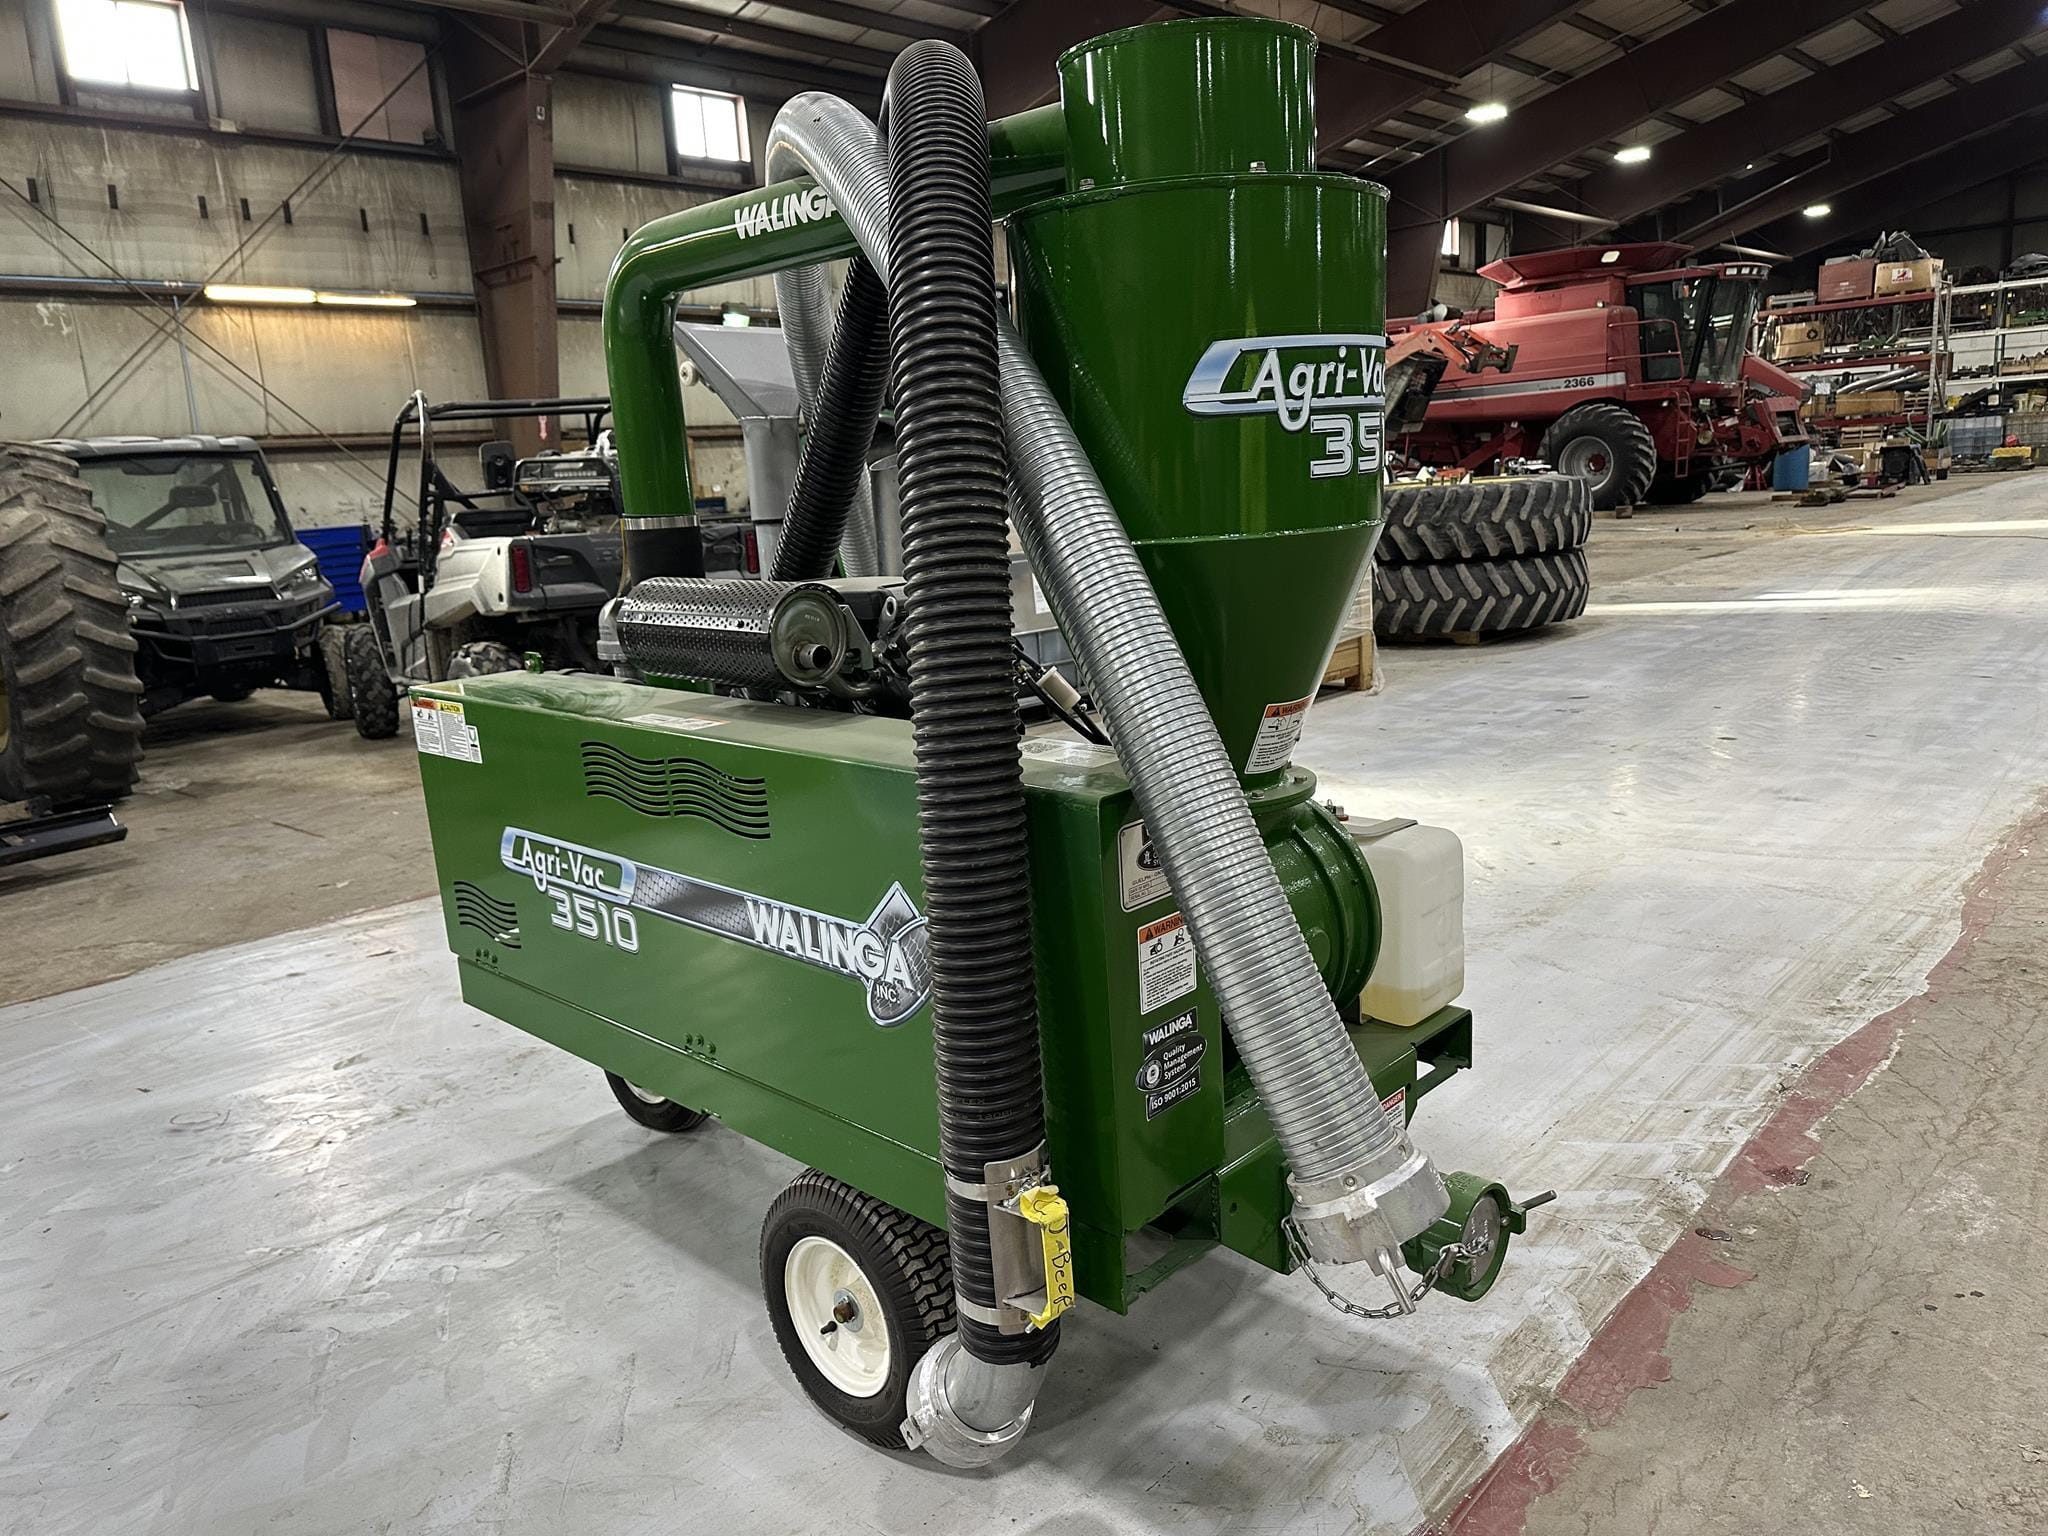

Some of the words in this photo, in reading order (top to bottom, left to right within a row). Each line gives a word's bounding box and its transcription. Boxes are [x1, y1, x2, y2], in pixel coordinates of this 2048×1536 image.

[1564, 376, 1595, 389] 2366
[1310, 411, 1385, 479] 35
[520, 836, 606, 893] Agri-Vac
[547, 884, 639, 954] 3510
[1153, 914, 1184, 936] WARNIN
[744, 896, 919, 995] WALINGA
[876, 983, 900, 1004] INC.
[1148, 1013, 1193, 1046] WALINGA
[1163, 1043, 1186, 1061] Quality
[1163, 1043, 1203, 1071] Management
[1164, 1062, 1187, 1080] System
[1150, 1096, 1163, 1110] ISO
[1164, 1077, 1196, 1103] 9001:2015
